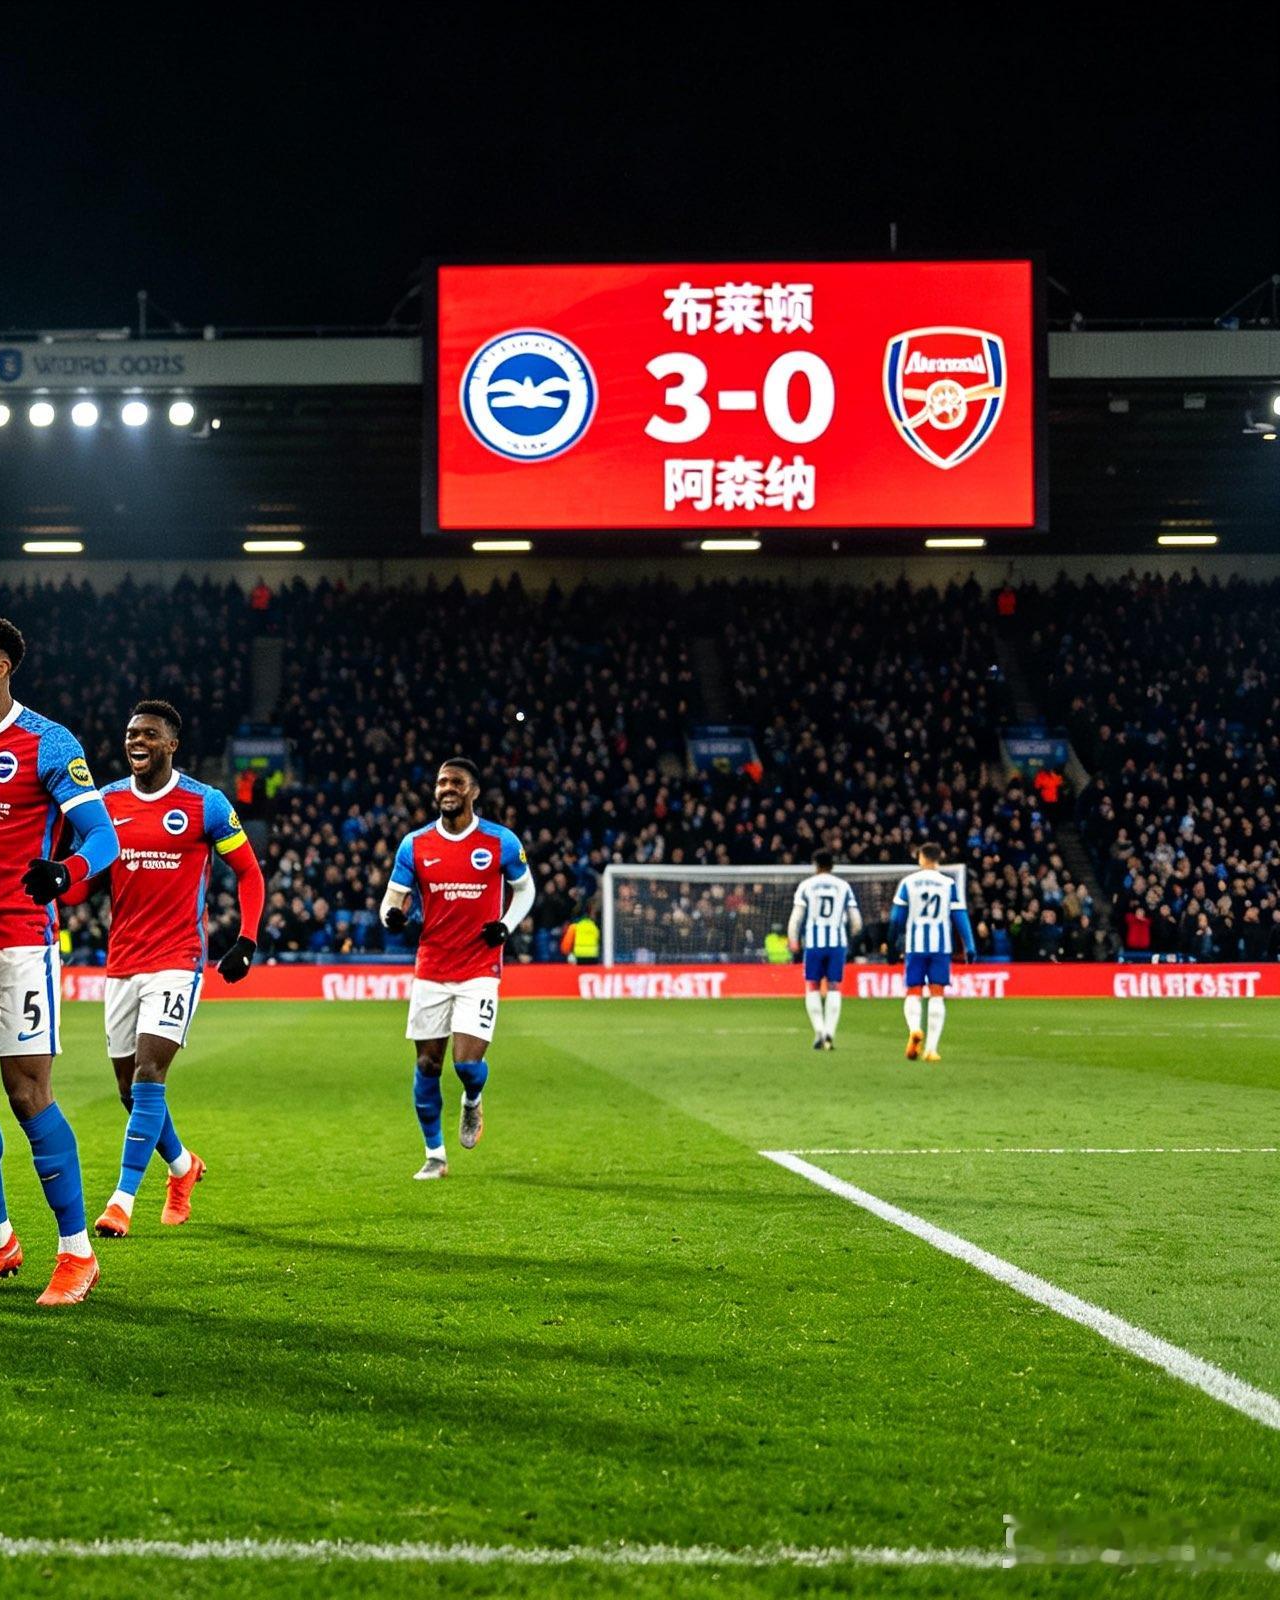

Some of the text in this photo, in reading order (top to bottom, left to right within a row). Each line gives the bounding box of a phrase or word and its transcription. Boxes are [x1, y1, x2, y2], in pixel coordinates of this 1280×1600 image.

[662, 281, 815, 336] 布莱顿
[644, 350, 835, 444] 3-0
[662, 455, 816, 512] 阿森纳
[20, 989, 41, 1031] 5
